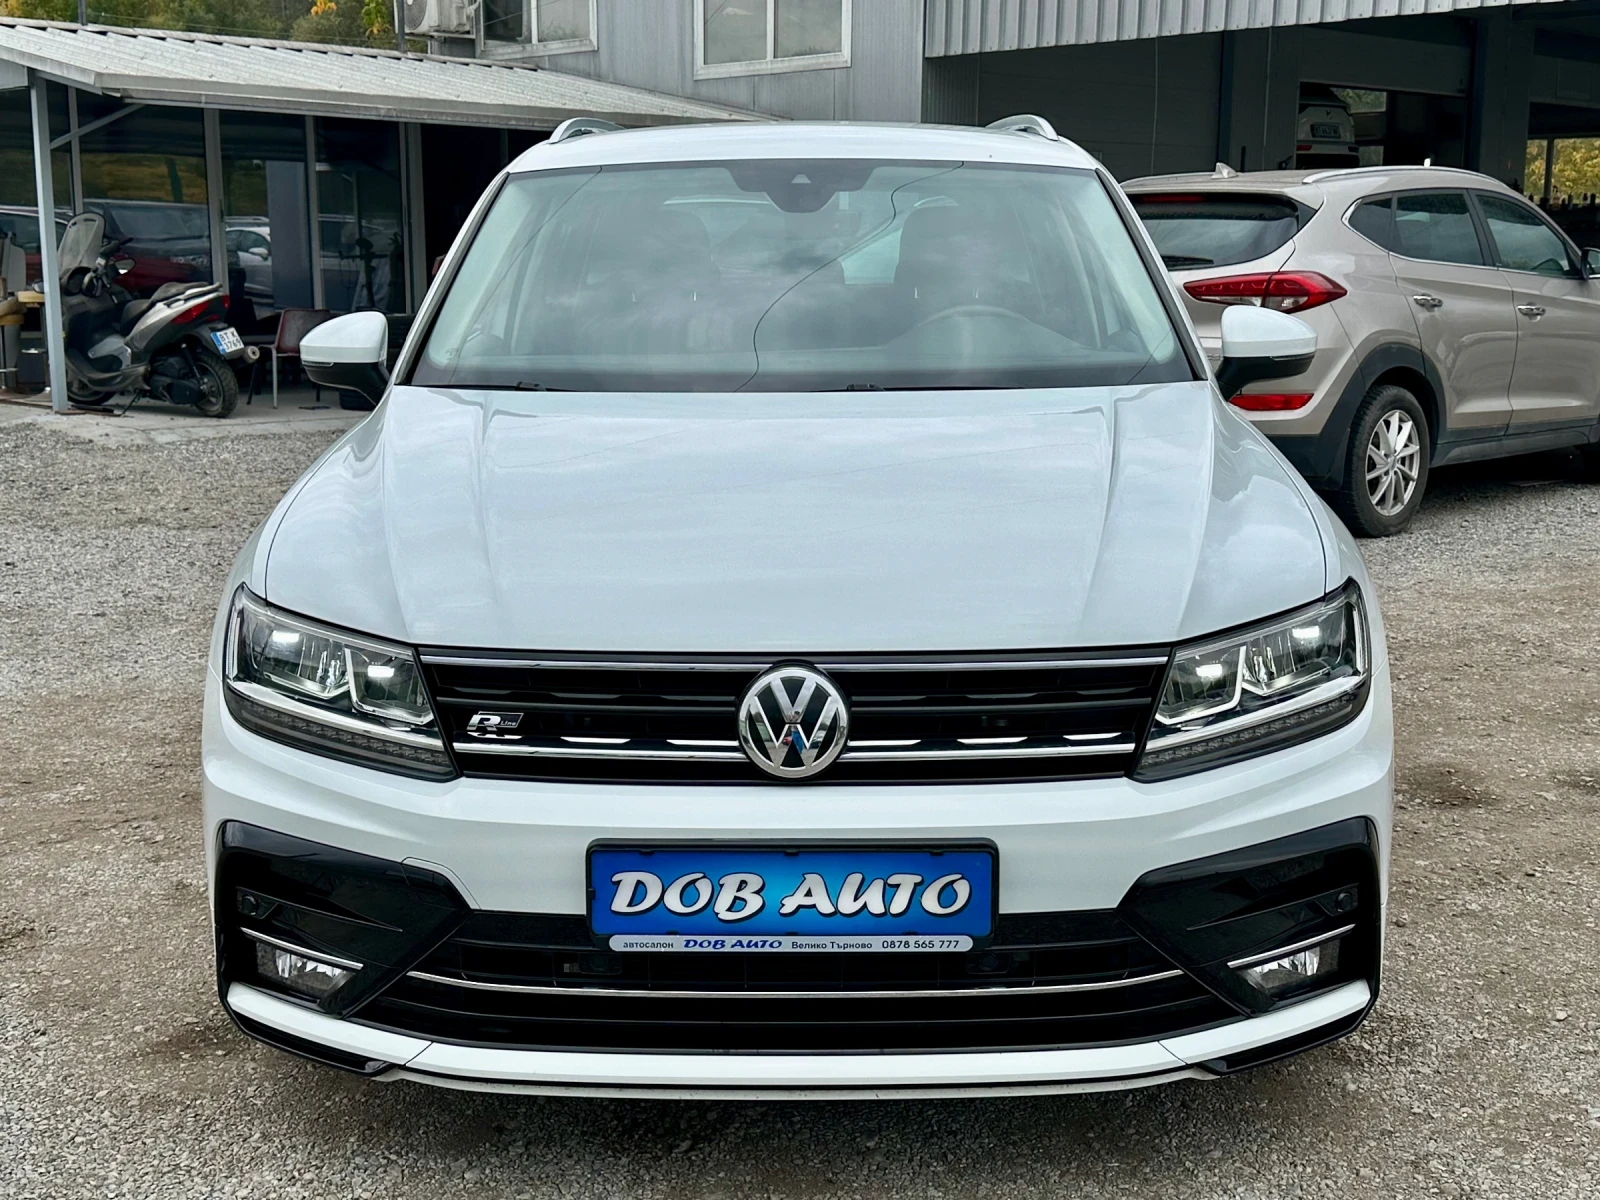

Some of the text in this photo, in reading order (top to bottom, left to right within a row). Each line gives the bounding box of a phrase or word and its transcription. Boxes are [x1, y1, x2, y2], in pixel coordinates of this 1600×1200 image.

[610, 871, 972, 921] DOB AUTO
[622, 939, 960, 950] автосалон DOB AUTO Велико Търново 0878 565 777
